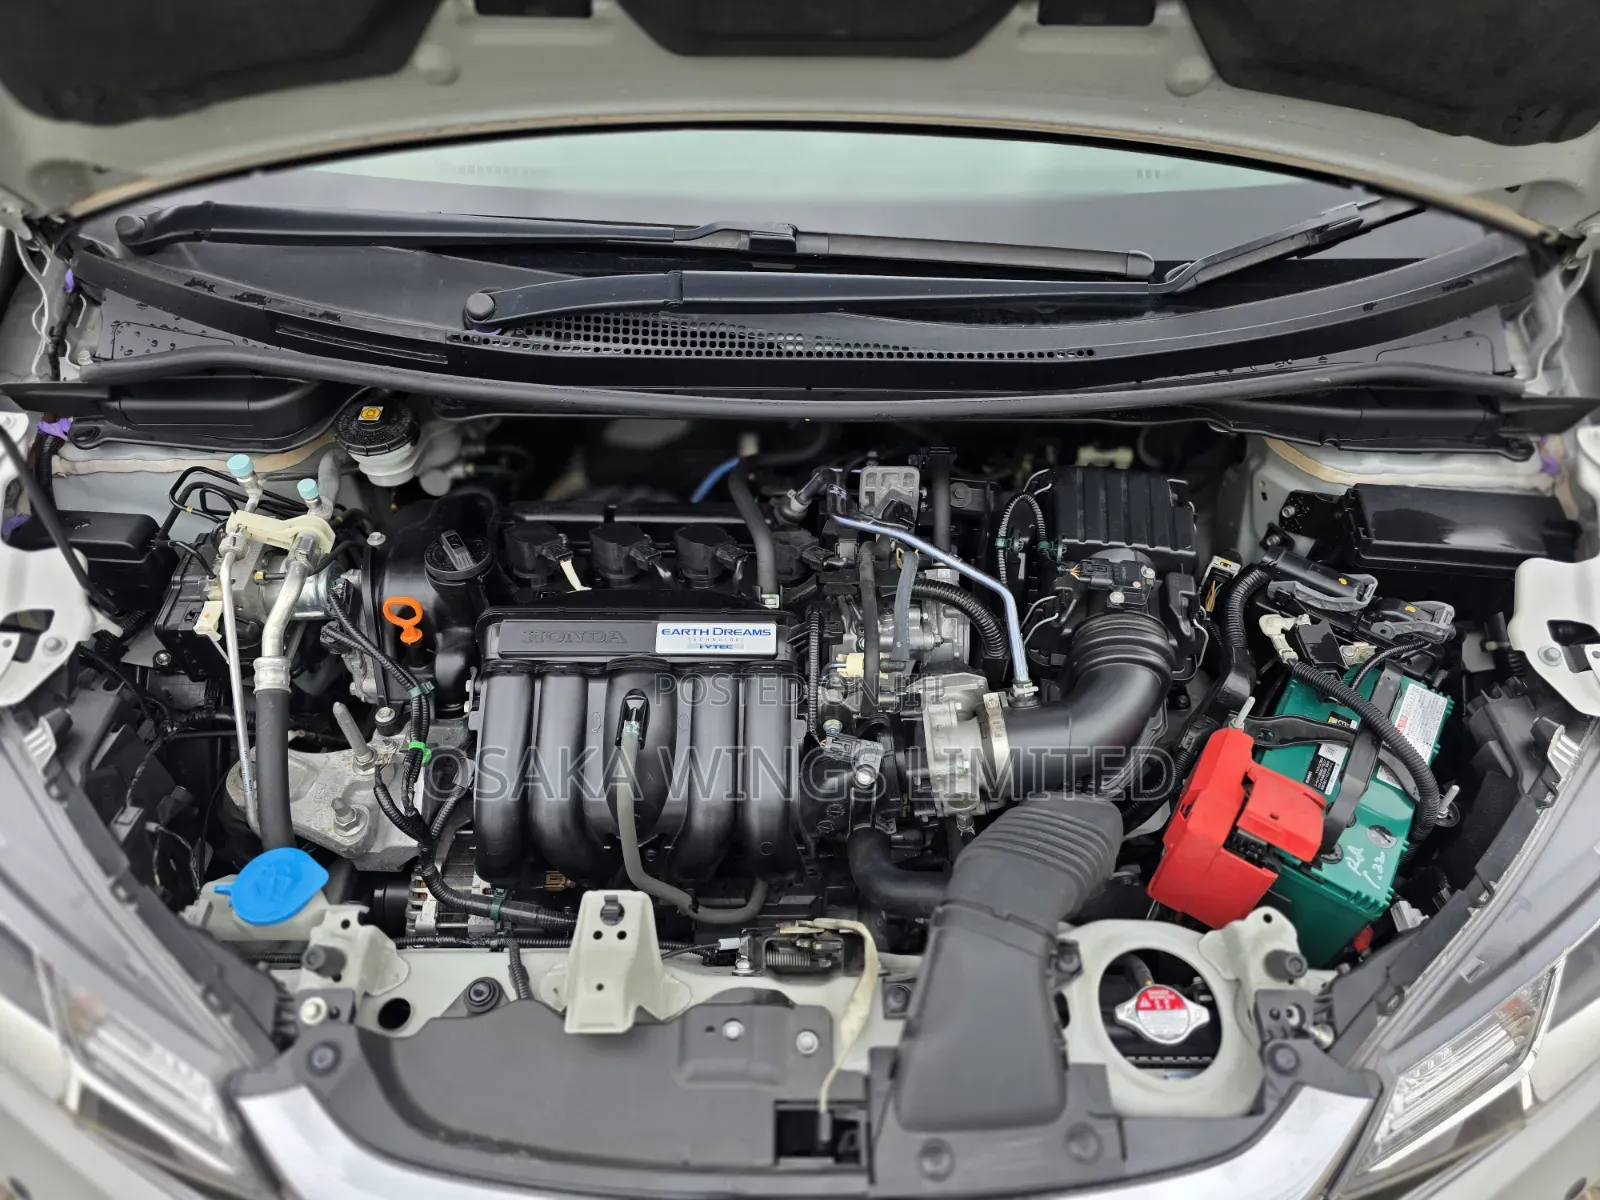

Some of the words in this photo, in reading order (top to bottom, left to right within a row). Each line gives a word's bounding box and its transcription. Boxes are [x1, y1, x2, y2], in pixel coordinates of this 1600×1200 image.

[522, 630, 628, 644] HONDA
[661, 628, 710, 636] EARTH
[712, 627, 772, 636] DREAMS
